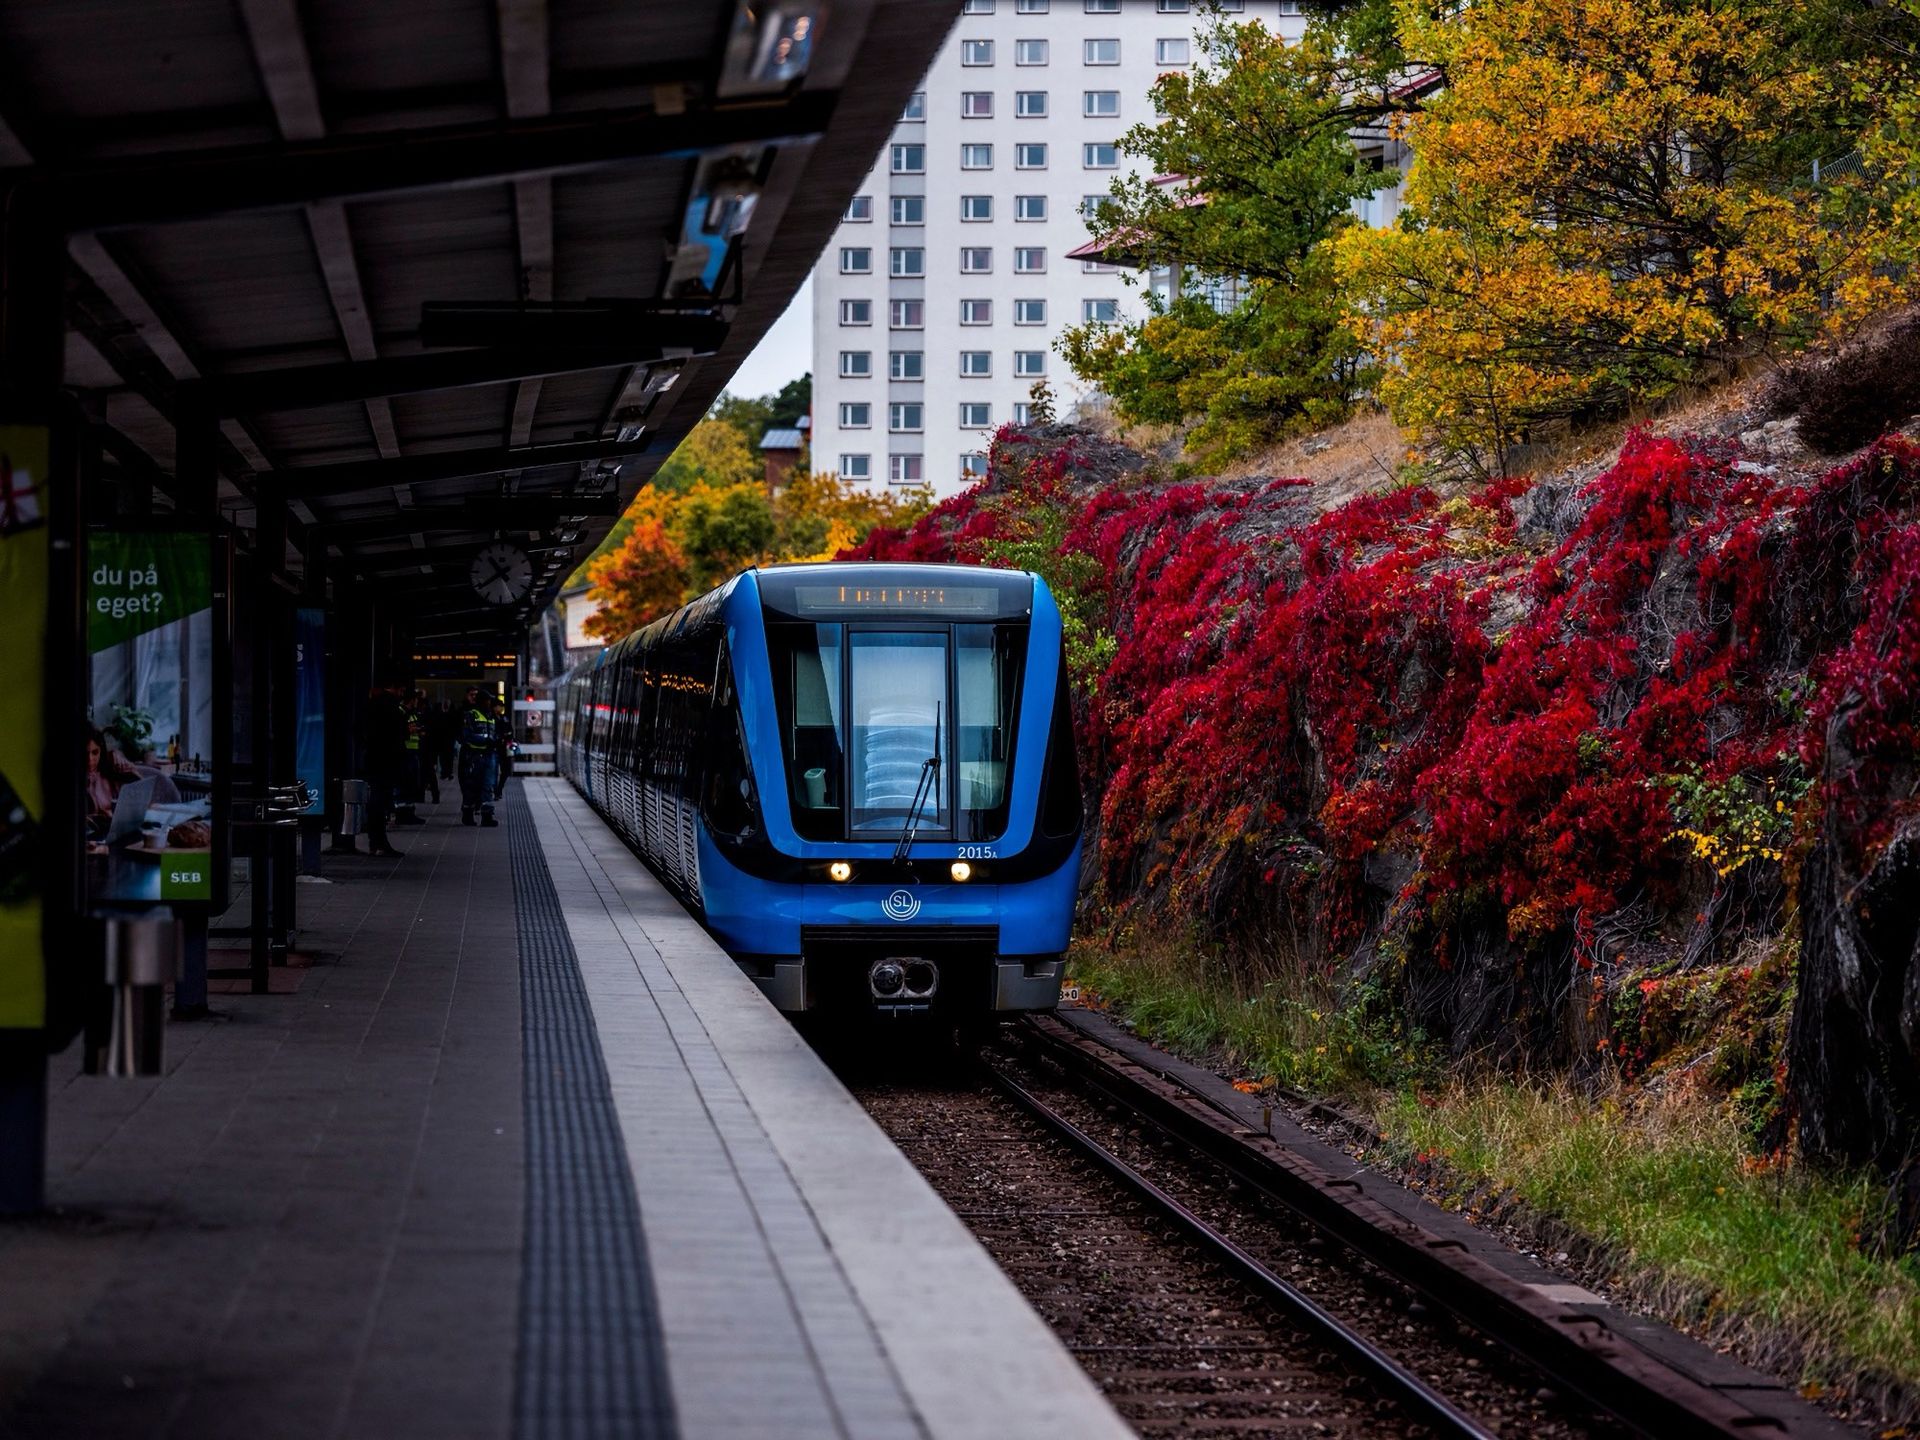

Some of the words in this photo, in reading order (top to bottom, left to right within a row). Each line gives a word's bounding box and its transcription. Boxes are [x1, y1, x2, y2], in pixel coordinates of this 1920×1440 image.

[92, 564, 123, 585] du
[129, 563, 158, 591] på
[96, 592, 164, 619] eget?
[170, 872, 202, 883] SEB
[893, 895, 910, 907] SL
